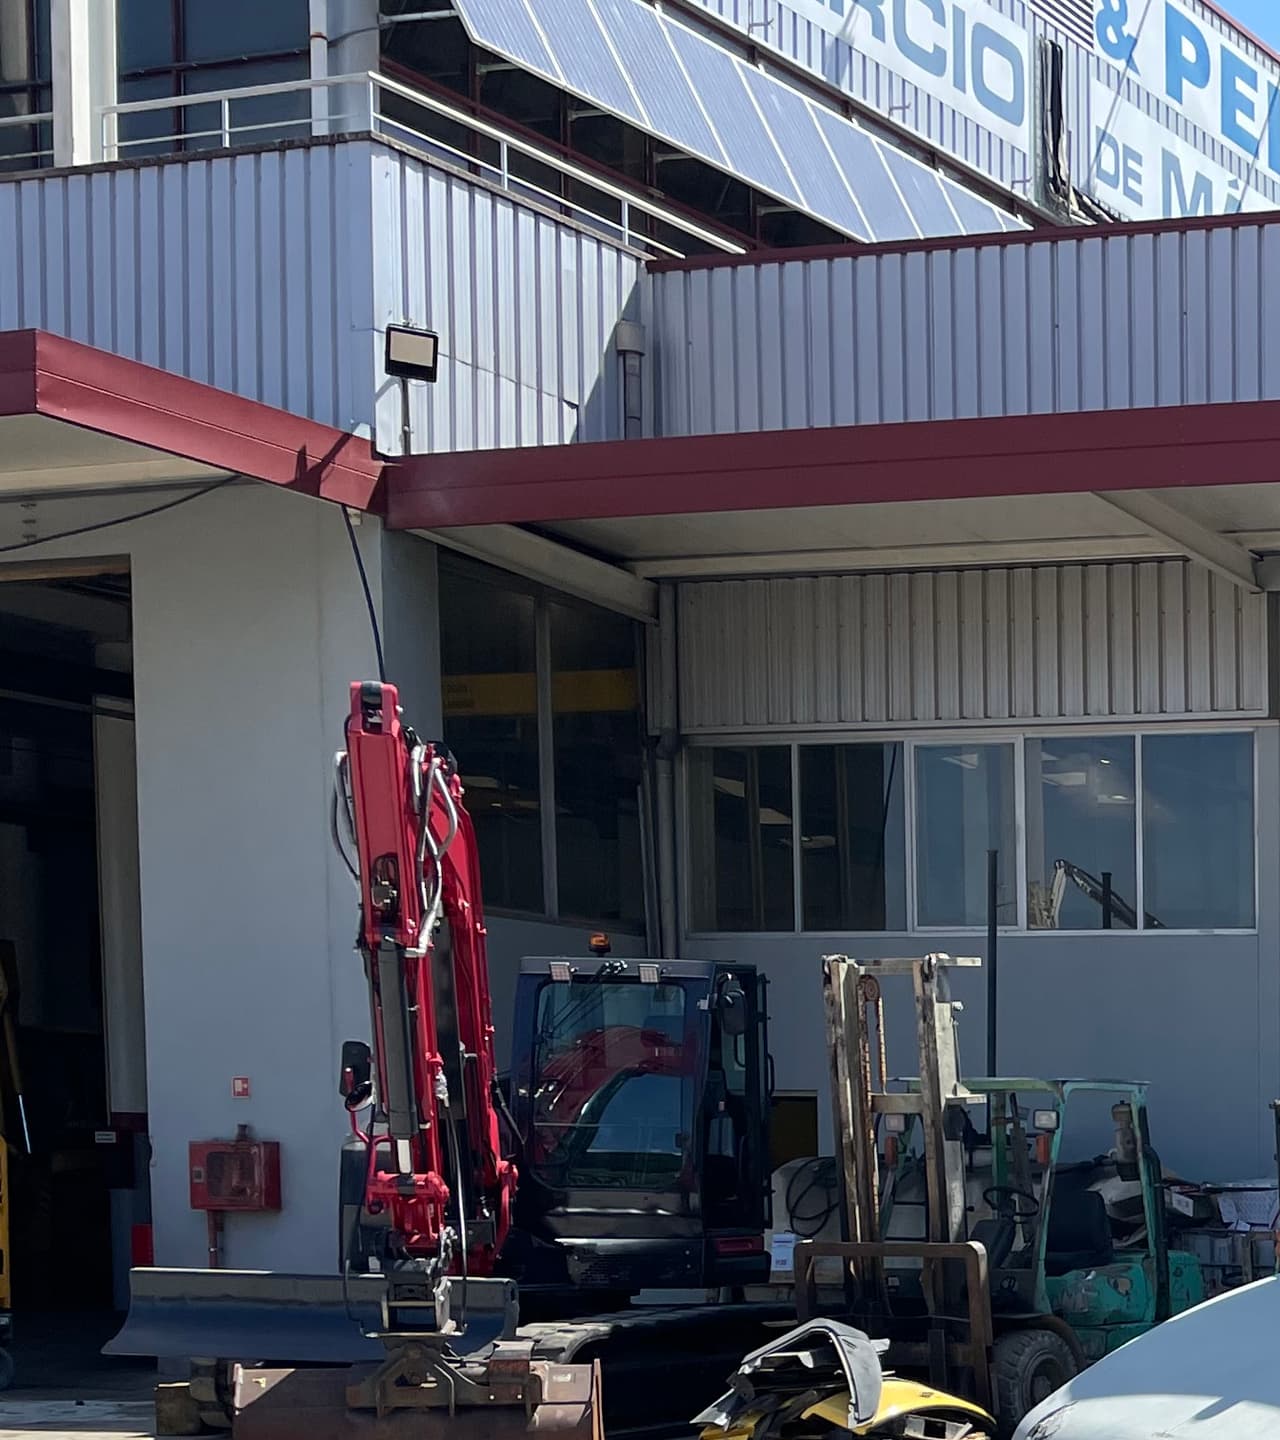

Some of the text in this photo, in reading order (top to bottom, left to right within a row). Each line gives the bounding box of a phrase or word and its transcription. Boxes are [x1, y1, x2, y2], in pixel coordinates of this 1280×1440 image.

[1095, 0, 1141, 77] &
[1095, 126, 1242, 218] DE M
